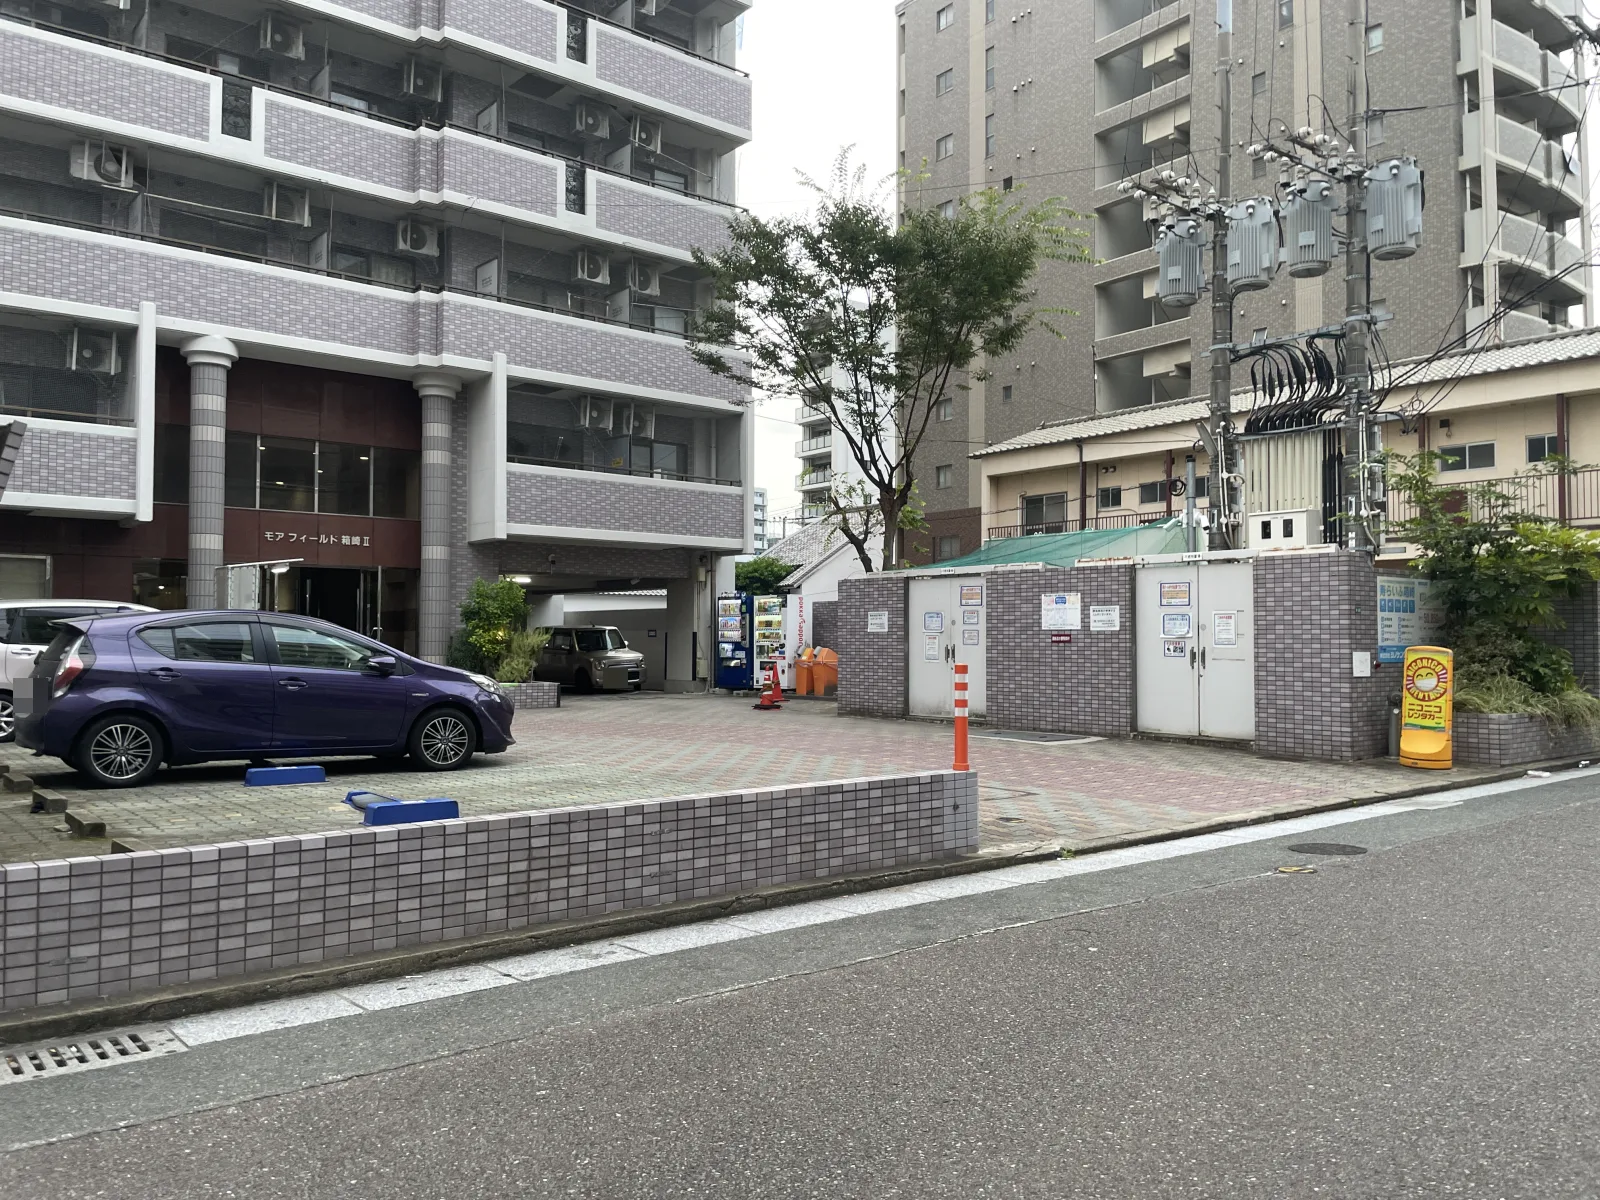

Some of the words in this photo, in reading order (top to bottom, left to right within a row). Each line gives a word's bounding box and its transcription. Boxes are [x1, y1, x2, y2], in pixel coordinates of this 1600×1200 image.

[1408, 702, 1443, 714] ニコニコ
[1407, 711, 1443, 721] レンタカー
